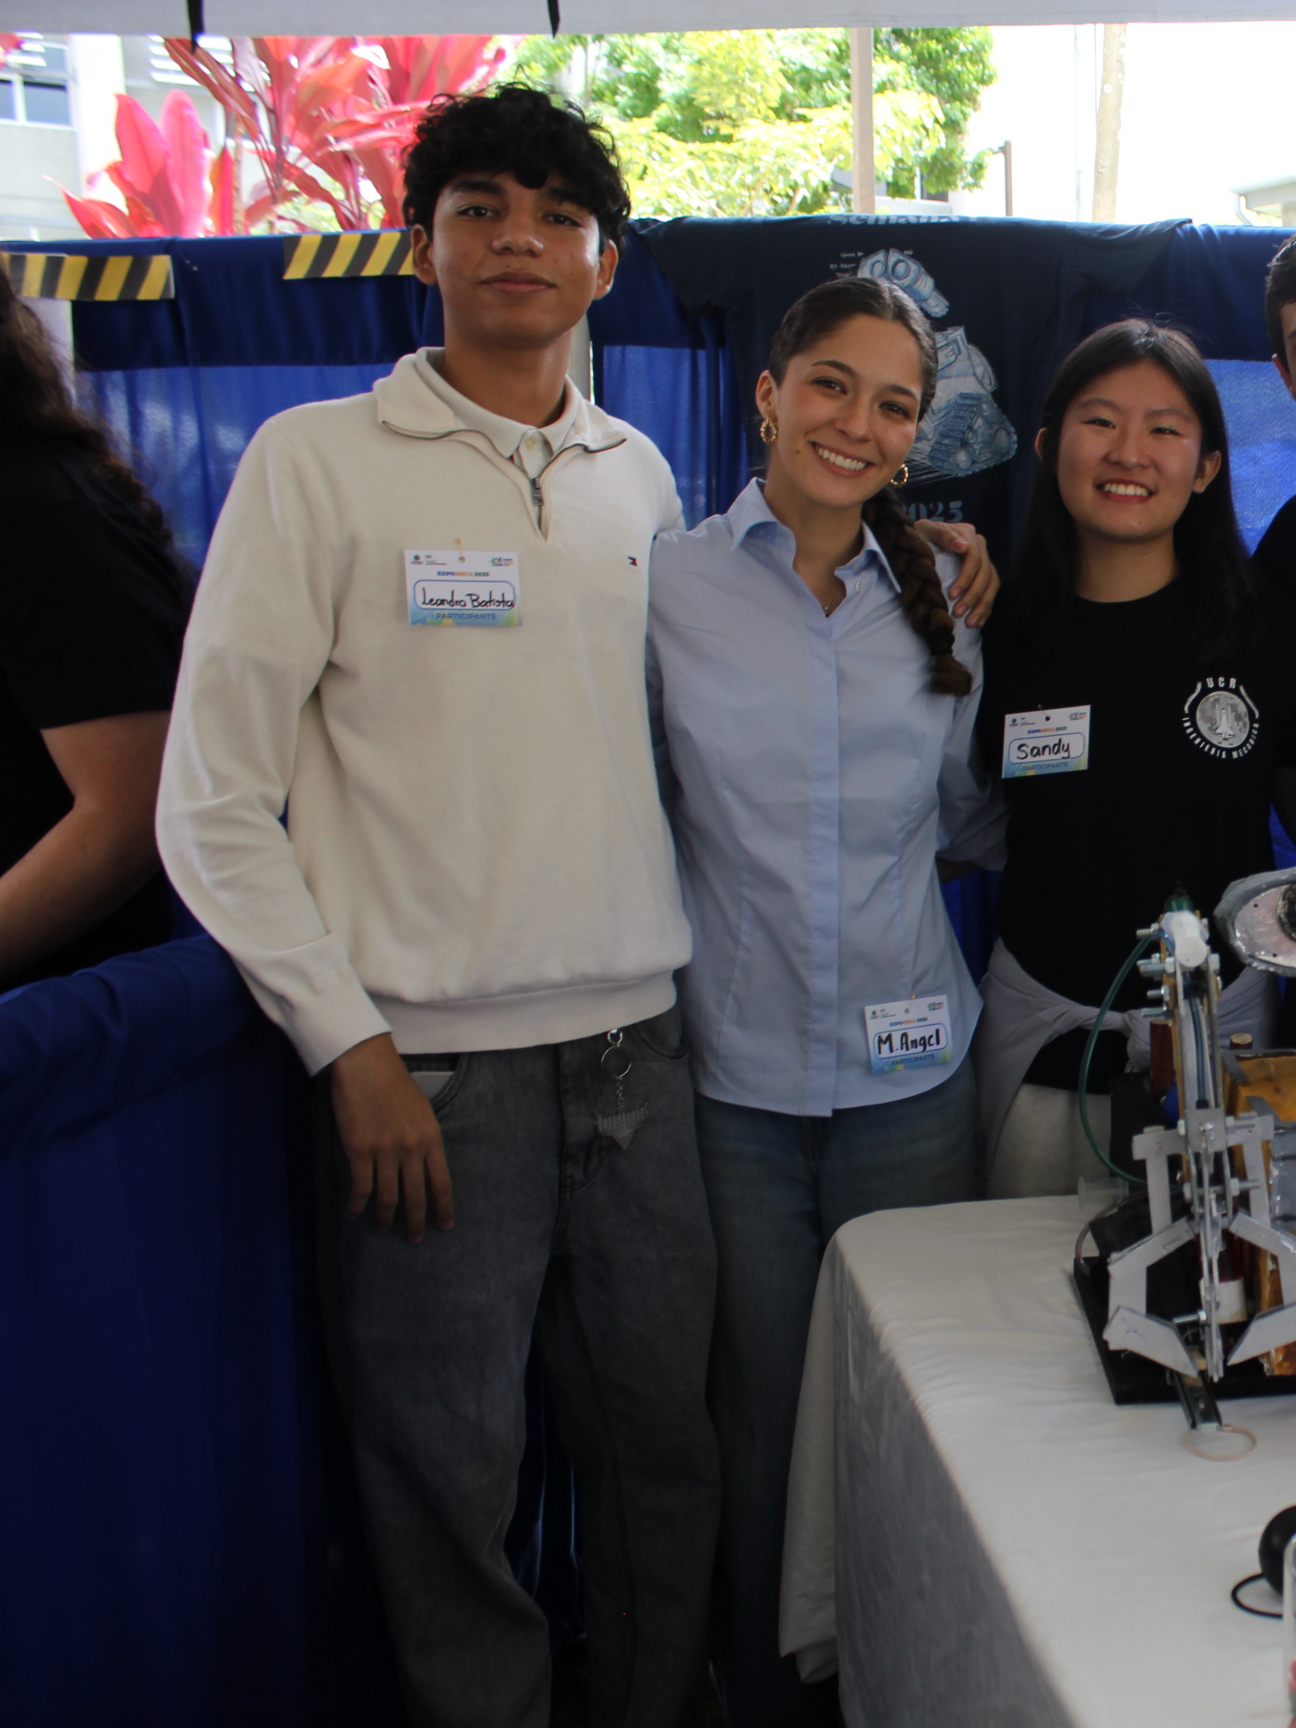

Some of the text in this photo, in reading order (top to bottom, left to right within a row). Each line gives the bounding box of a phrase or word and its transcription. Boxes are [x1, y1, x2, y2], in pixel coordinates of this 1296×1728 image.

[902, 501, 963, 523] 025
[1206, 677, 1237, 689] UCR
[1016, 737, 1070, 760] Sandy
